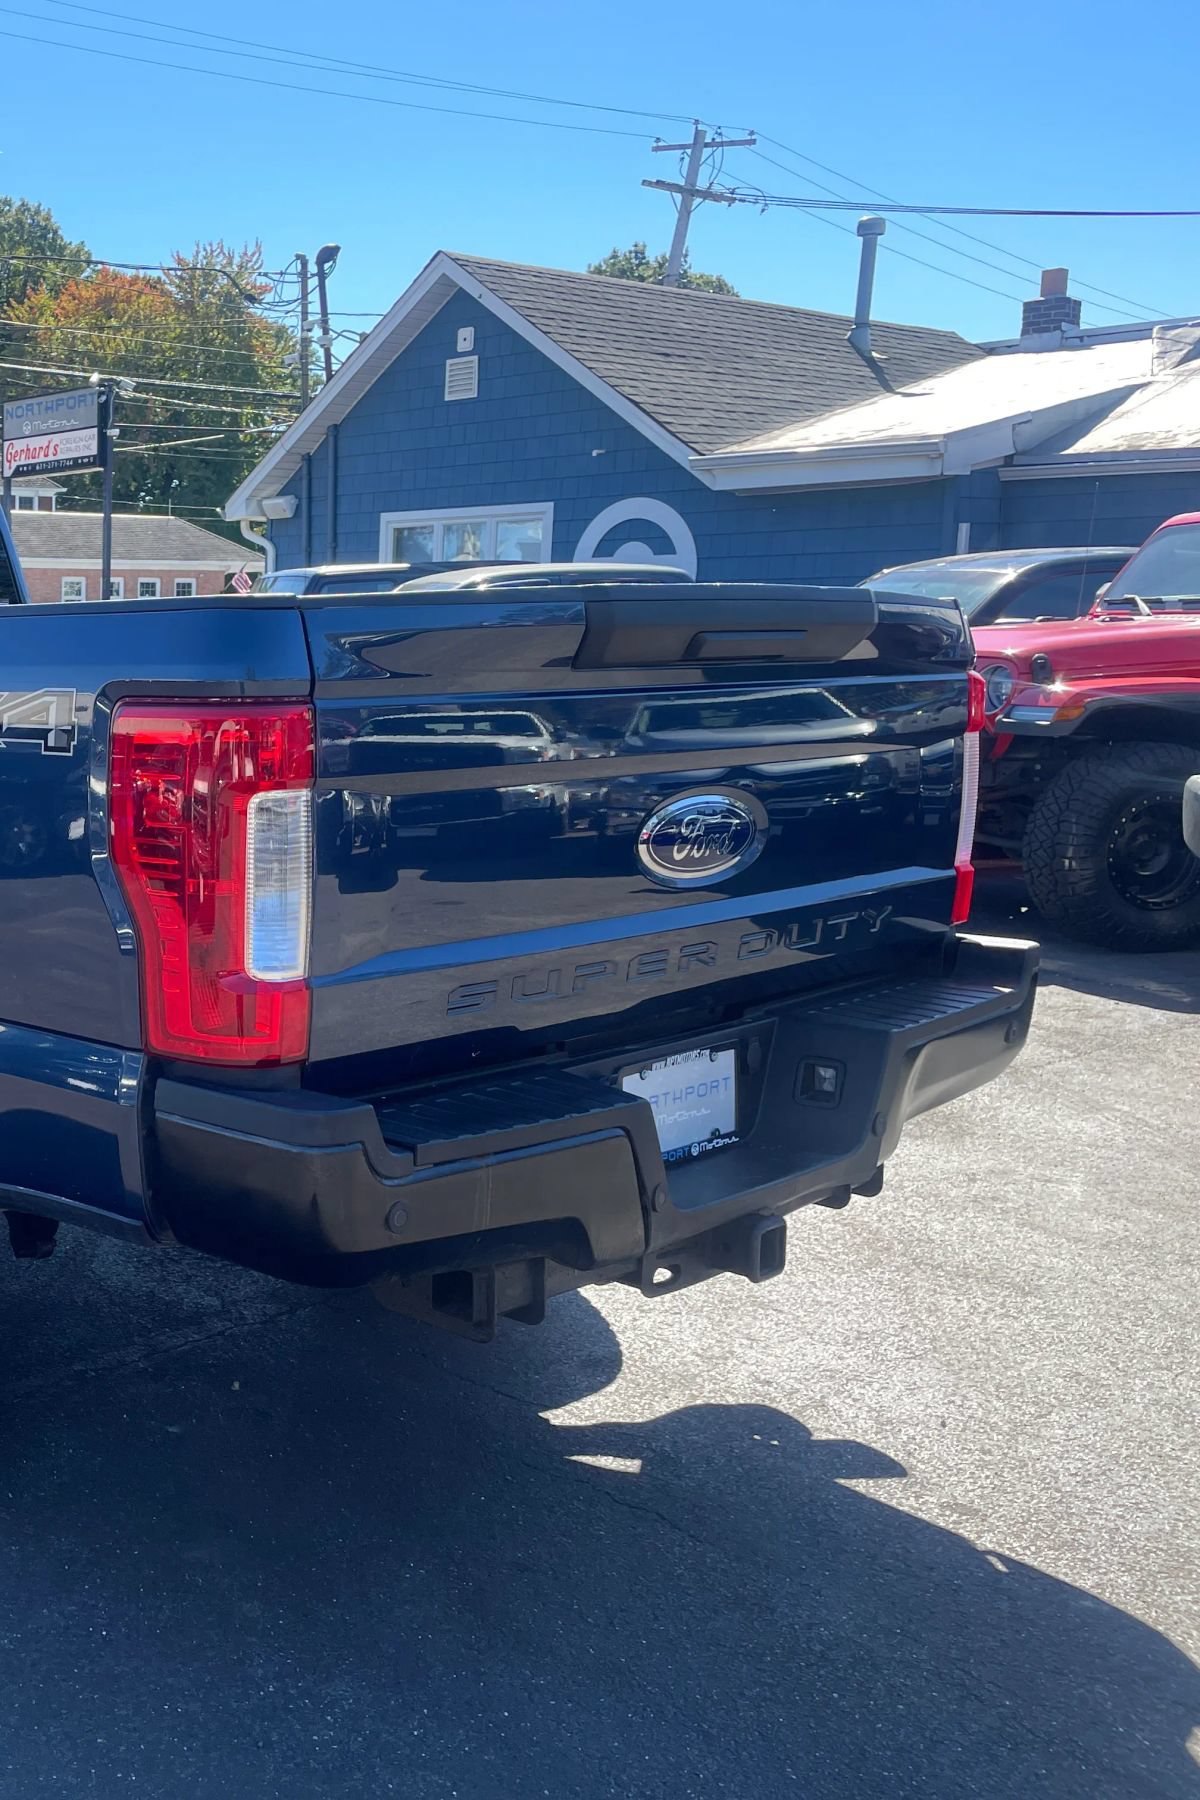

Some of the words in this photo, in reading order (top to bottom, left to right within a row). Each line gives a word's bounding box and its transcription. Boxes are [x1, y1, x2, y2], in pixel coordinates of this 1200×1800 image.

[6, 392, 97, 420] NORTHPORT
[5, 437, 60, 470] Gerhard's
[673, 812, 740, 861] Ford
[446, 940, 719, 1016] SUPER
[737, 905, 892, 961] DUTY
[649, 1076, 731, 1108] RTHPORT
